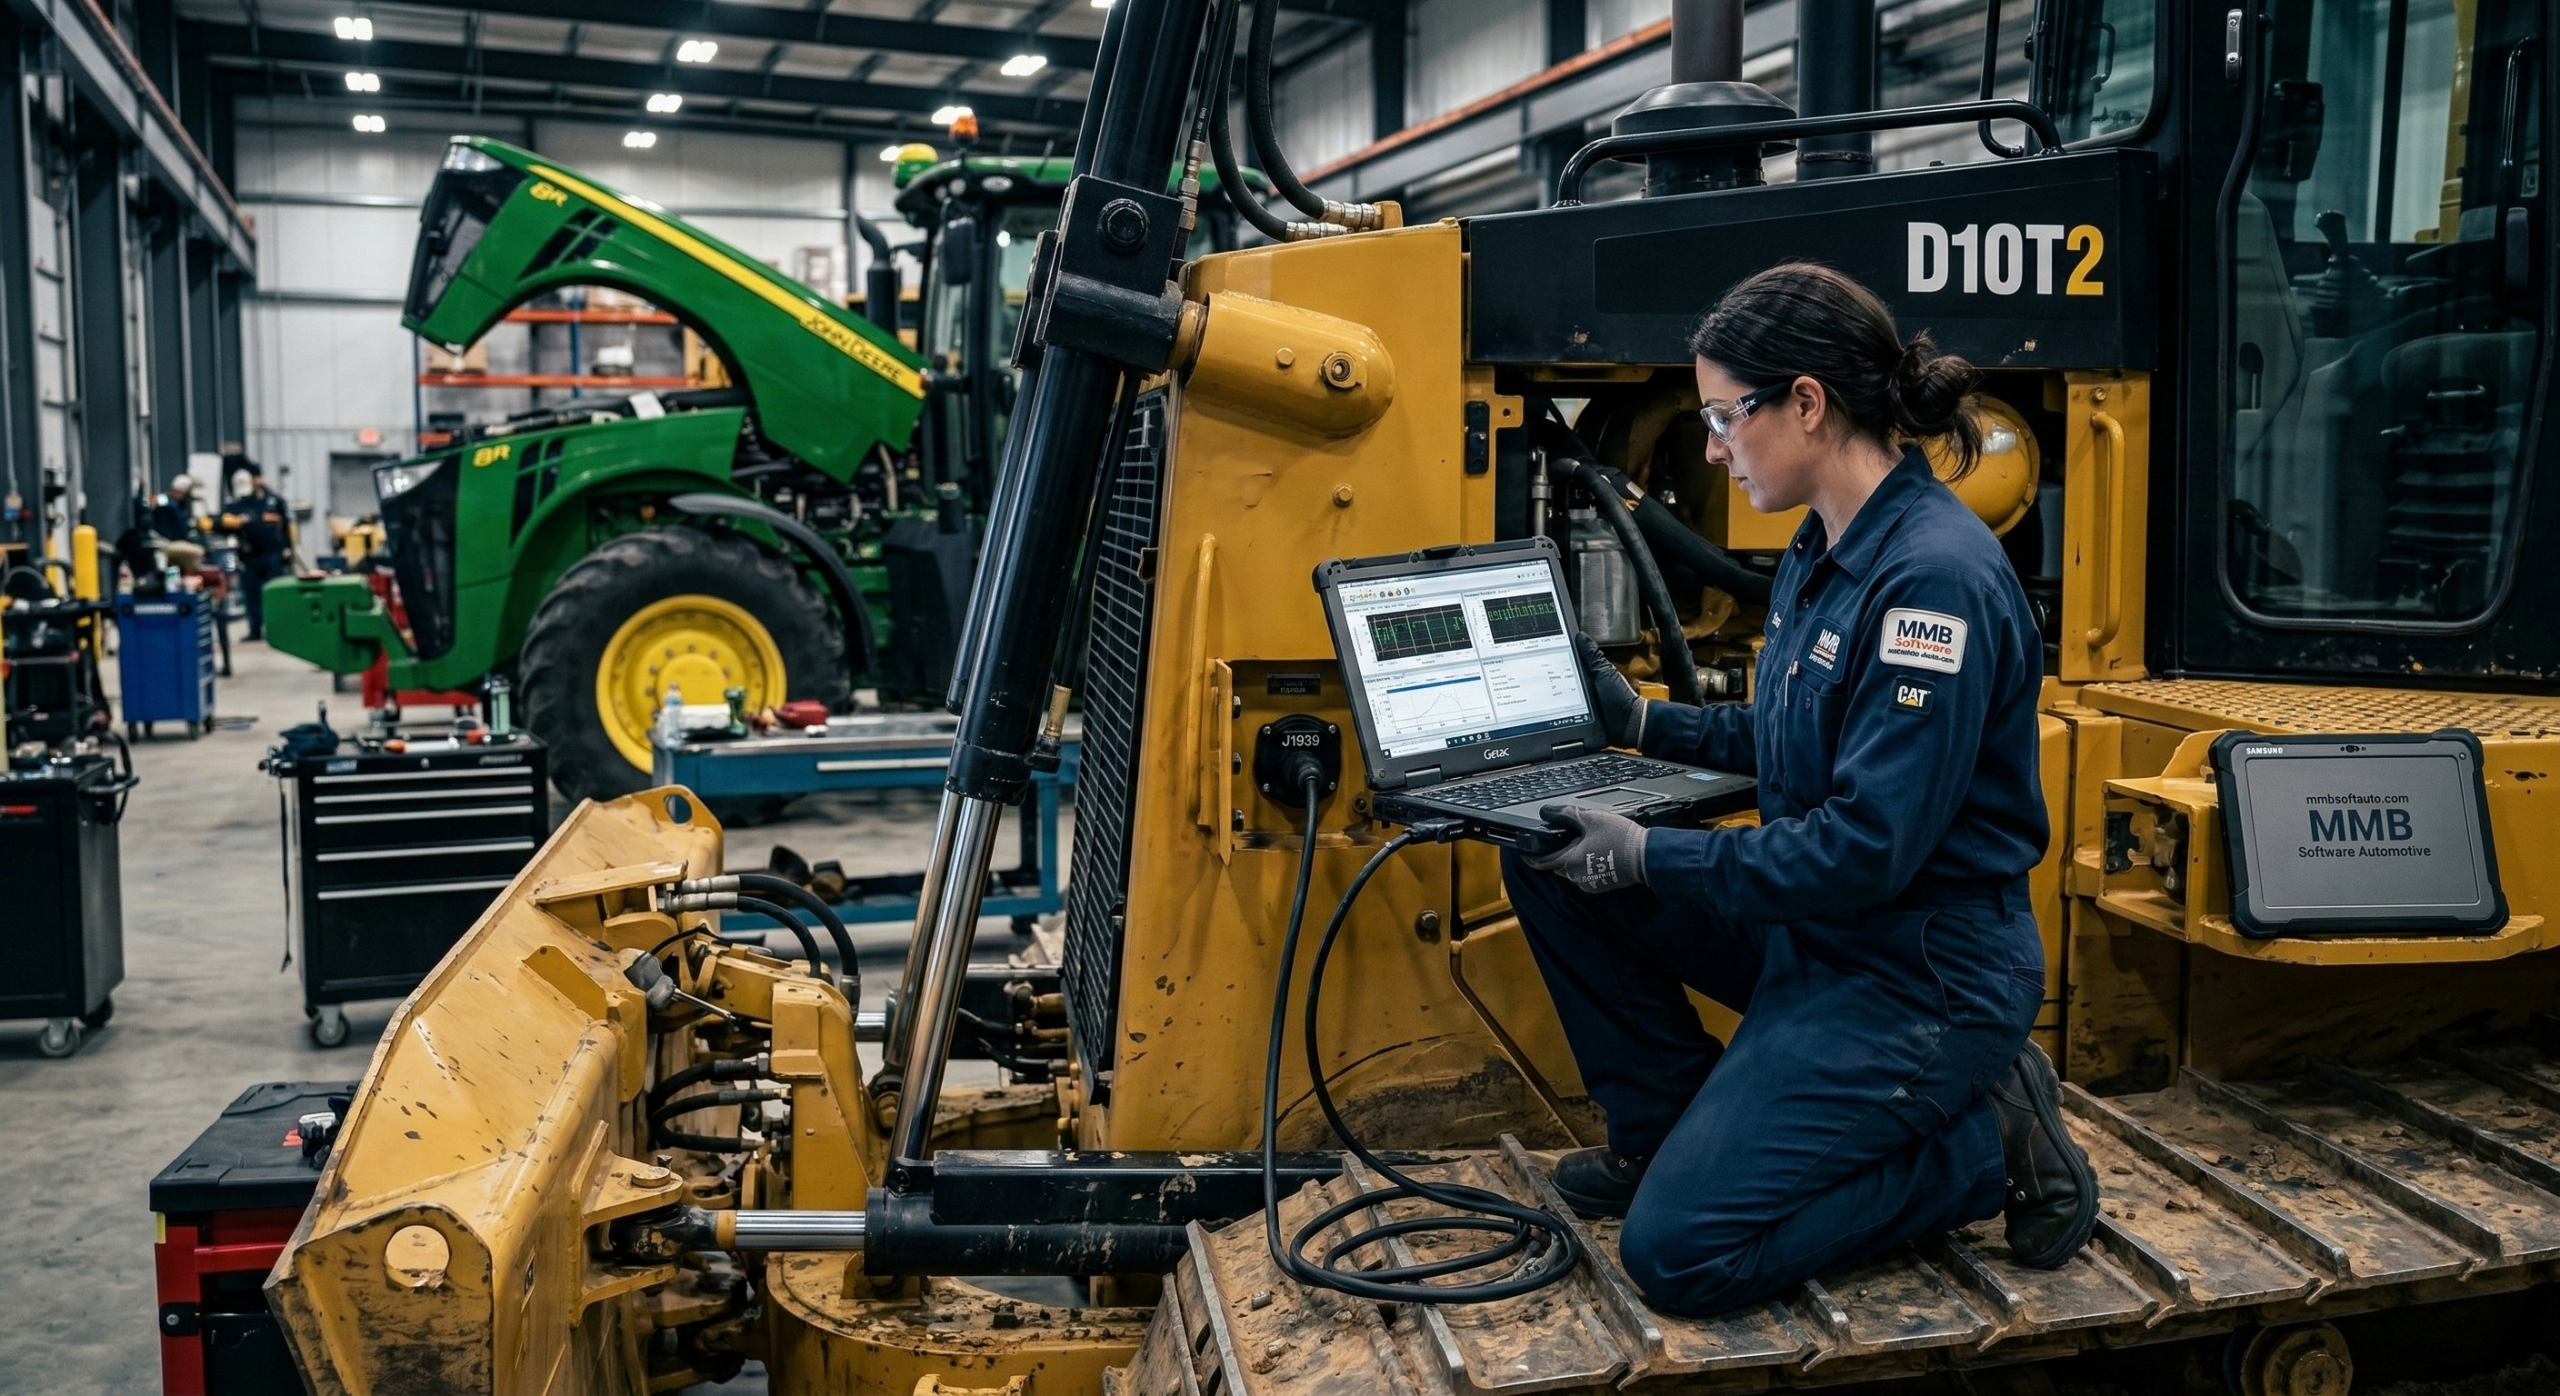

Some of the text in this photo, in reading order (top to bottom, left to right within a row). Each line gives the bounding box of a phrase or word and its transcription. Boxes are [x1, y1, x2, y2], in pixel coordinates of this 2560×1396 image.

[529, 181, 568, 208] 8R
[1907, 221, 2104, 296] D10T2
[806, 315, 902, 379] JOHN DEERE
[472, 443, 511, 468] 8R
[1896, 619, 1953, 645] MMB
[1894, 637, 1952, 655] Software
[1897, 684, 1928, 708] CAT
[1281, 734, 1320, 747] J1939
[2306, 793, 2409, 805] mmbsoftauto.com
[2308, 808, 2413, 843] MMB
[2298, 845, 2431, 858] Software Automotive
